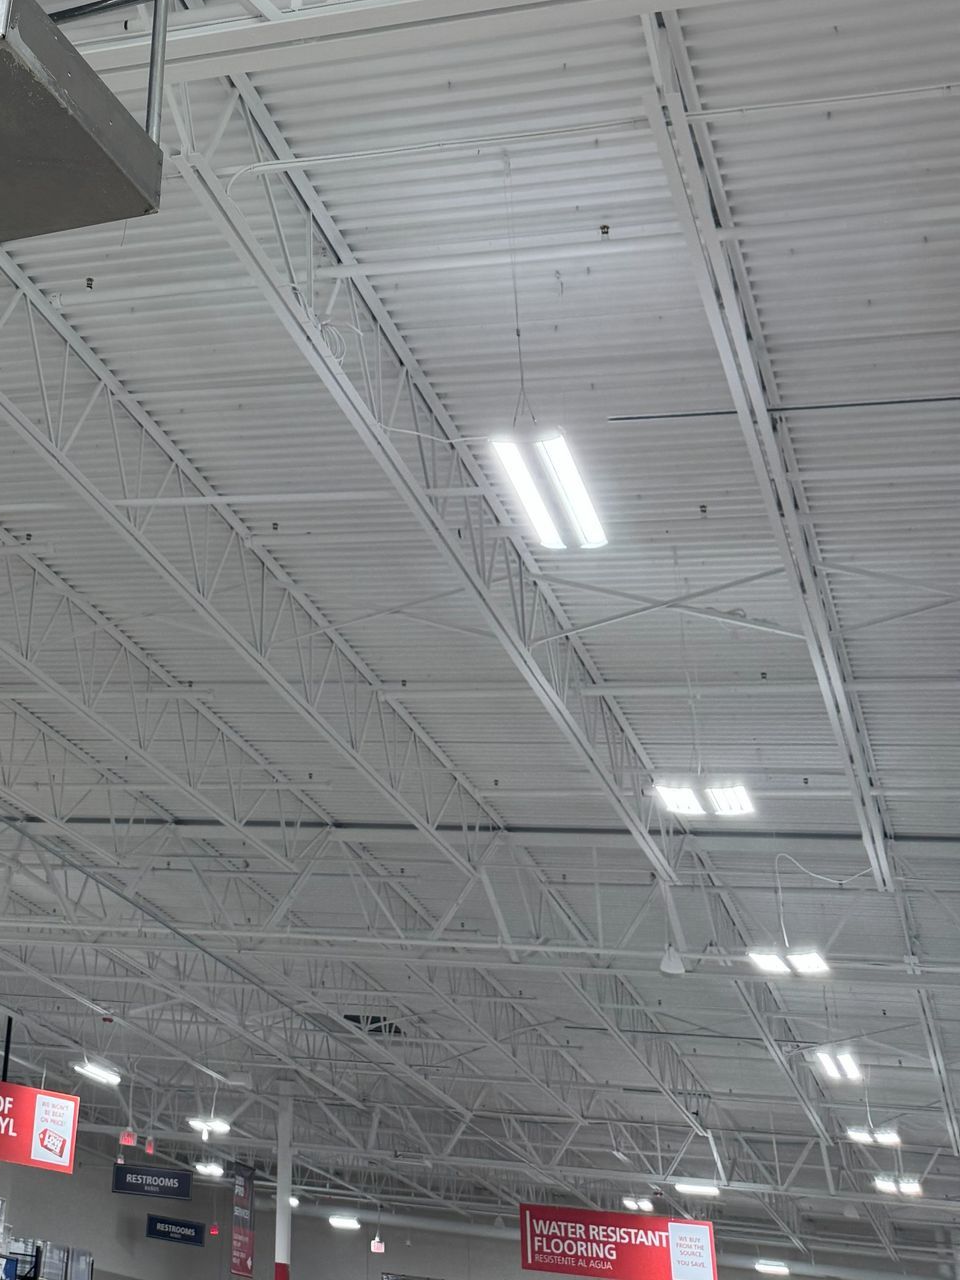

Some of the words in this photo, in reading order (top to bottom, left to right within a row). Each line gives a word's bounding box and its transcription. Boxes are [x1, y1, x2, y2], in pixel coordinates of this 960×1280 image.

[126, 1173, 179, 1188] RESTROOMS
[156, 1222, 196, 1237] RESTROOMS
[533, 1219, 586, 1239] WATER
[590, 1225, 669, 1248] RESISTANT
[534, 1236, 617, 1260] FLOORING
[534, 1254, 575, 1266] RESISTENTE
[577, 1258, 587, 1268] AL
[589, 1260, 613, 1270] AGUA
